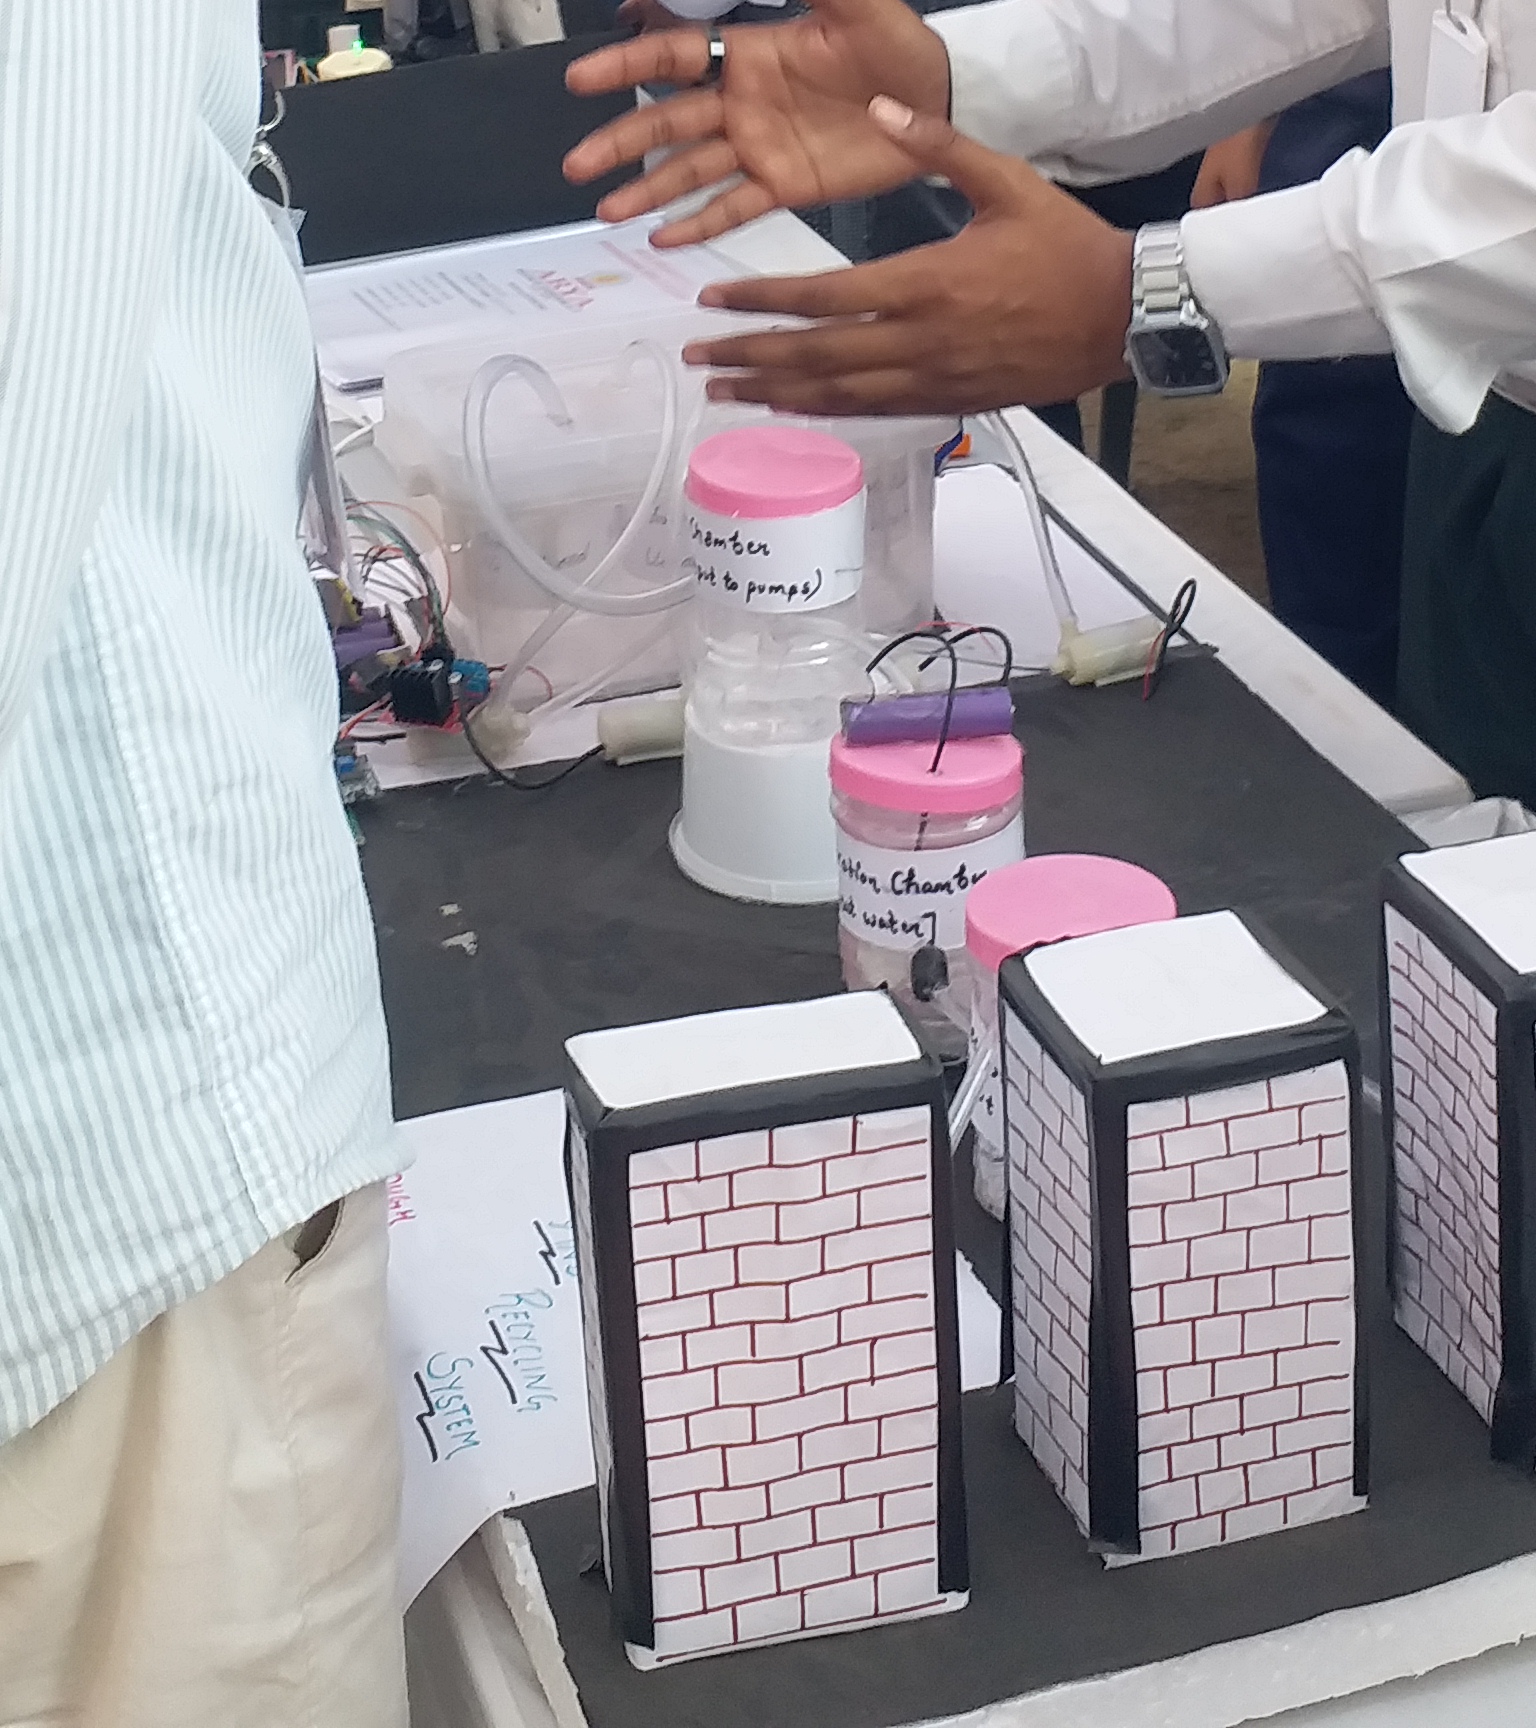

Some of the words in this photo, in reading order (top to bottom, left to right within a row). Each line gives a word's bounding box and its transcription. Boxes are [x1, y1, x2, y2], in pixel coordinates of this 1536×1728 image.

[722, 570, 740, 593] to
[426, 1350, 481, 1462] SYSTEM
[483, 1287, 558, 1414] RECYCLING
